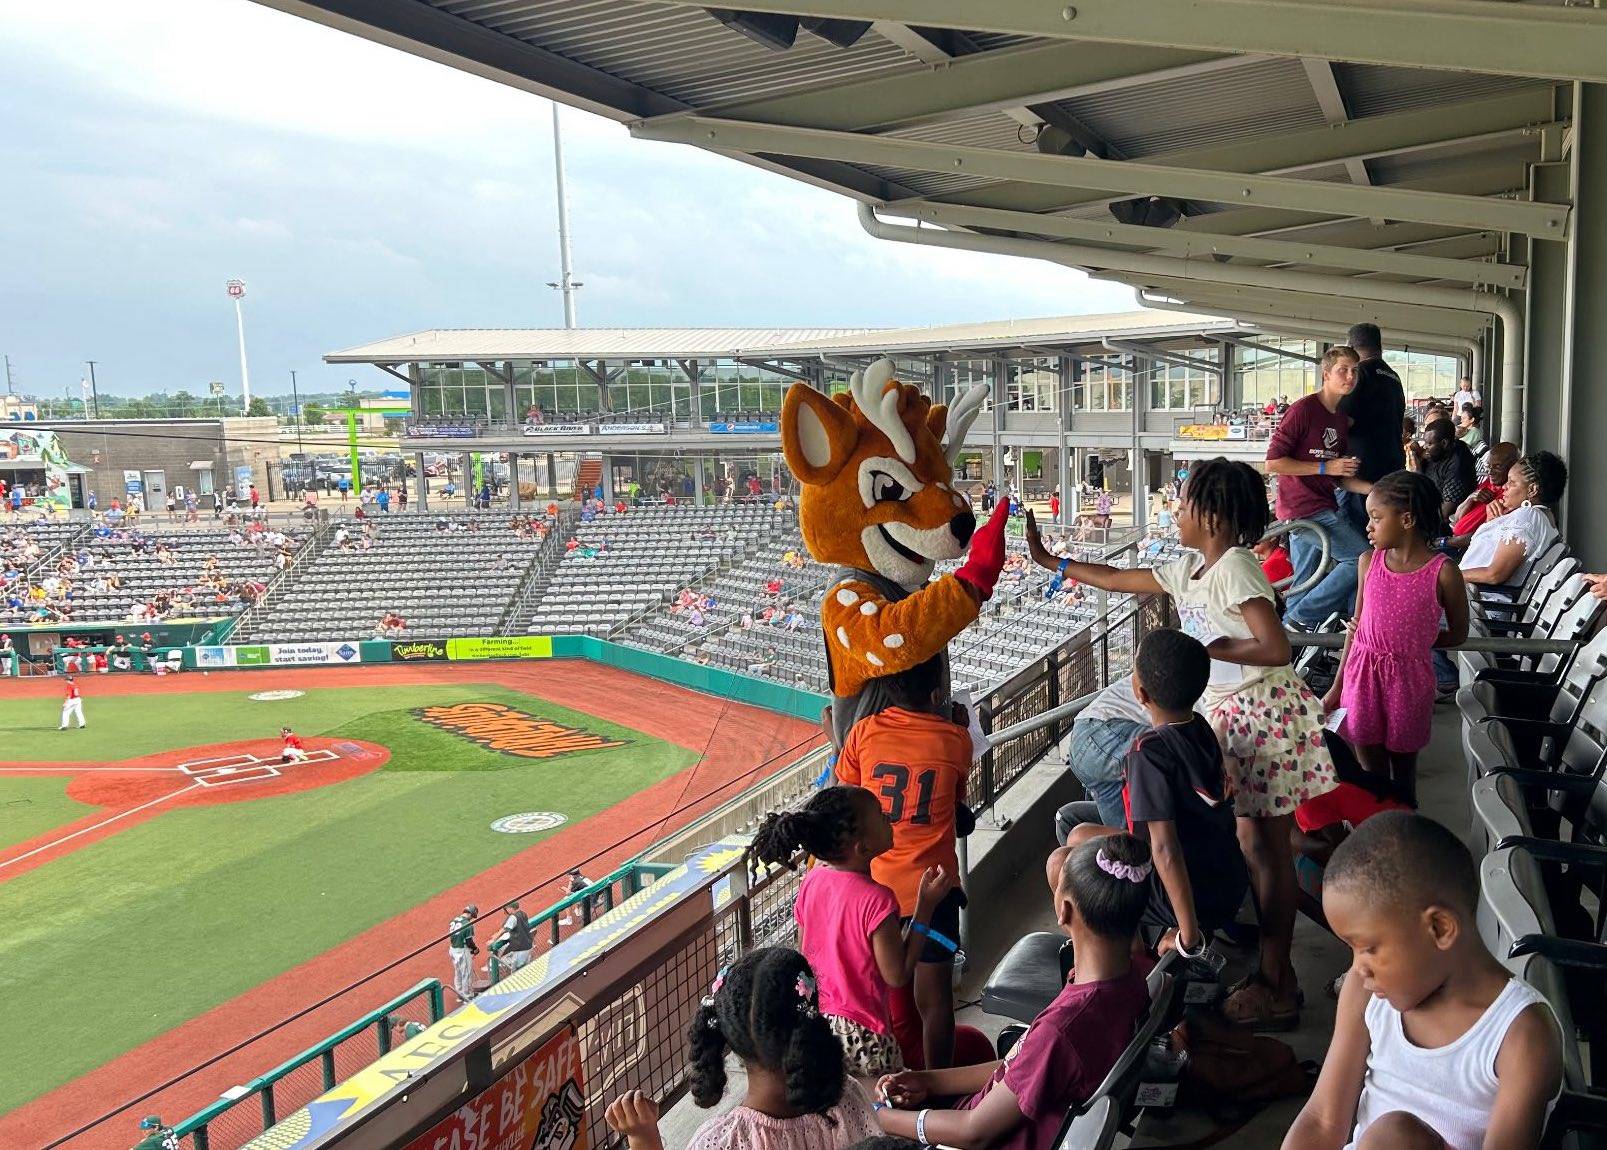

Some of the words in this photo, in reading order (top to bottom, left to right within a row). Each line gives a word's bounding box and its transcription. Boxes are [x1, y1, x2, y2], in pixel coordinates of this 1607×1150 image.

[278, 647, 296, 655] Join
[298, 654, 329, 663] saving!
[871, 762, 937, 825] 31
[530, 1036, 576, 1108] SAFE
